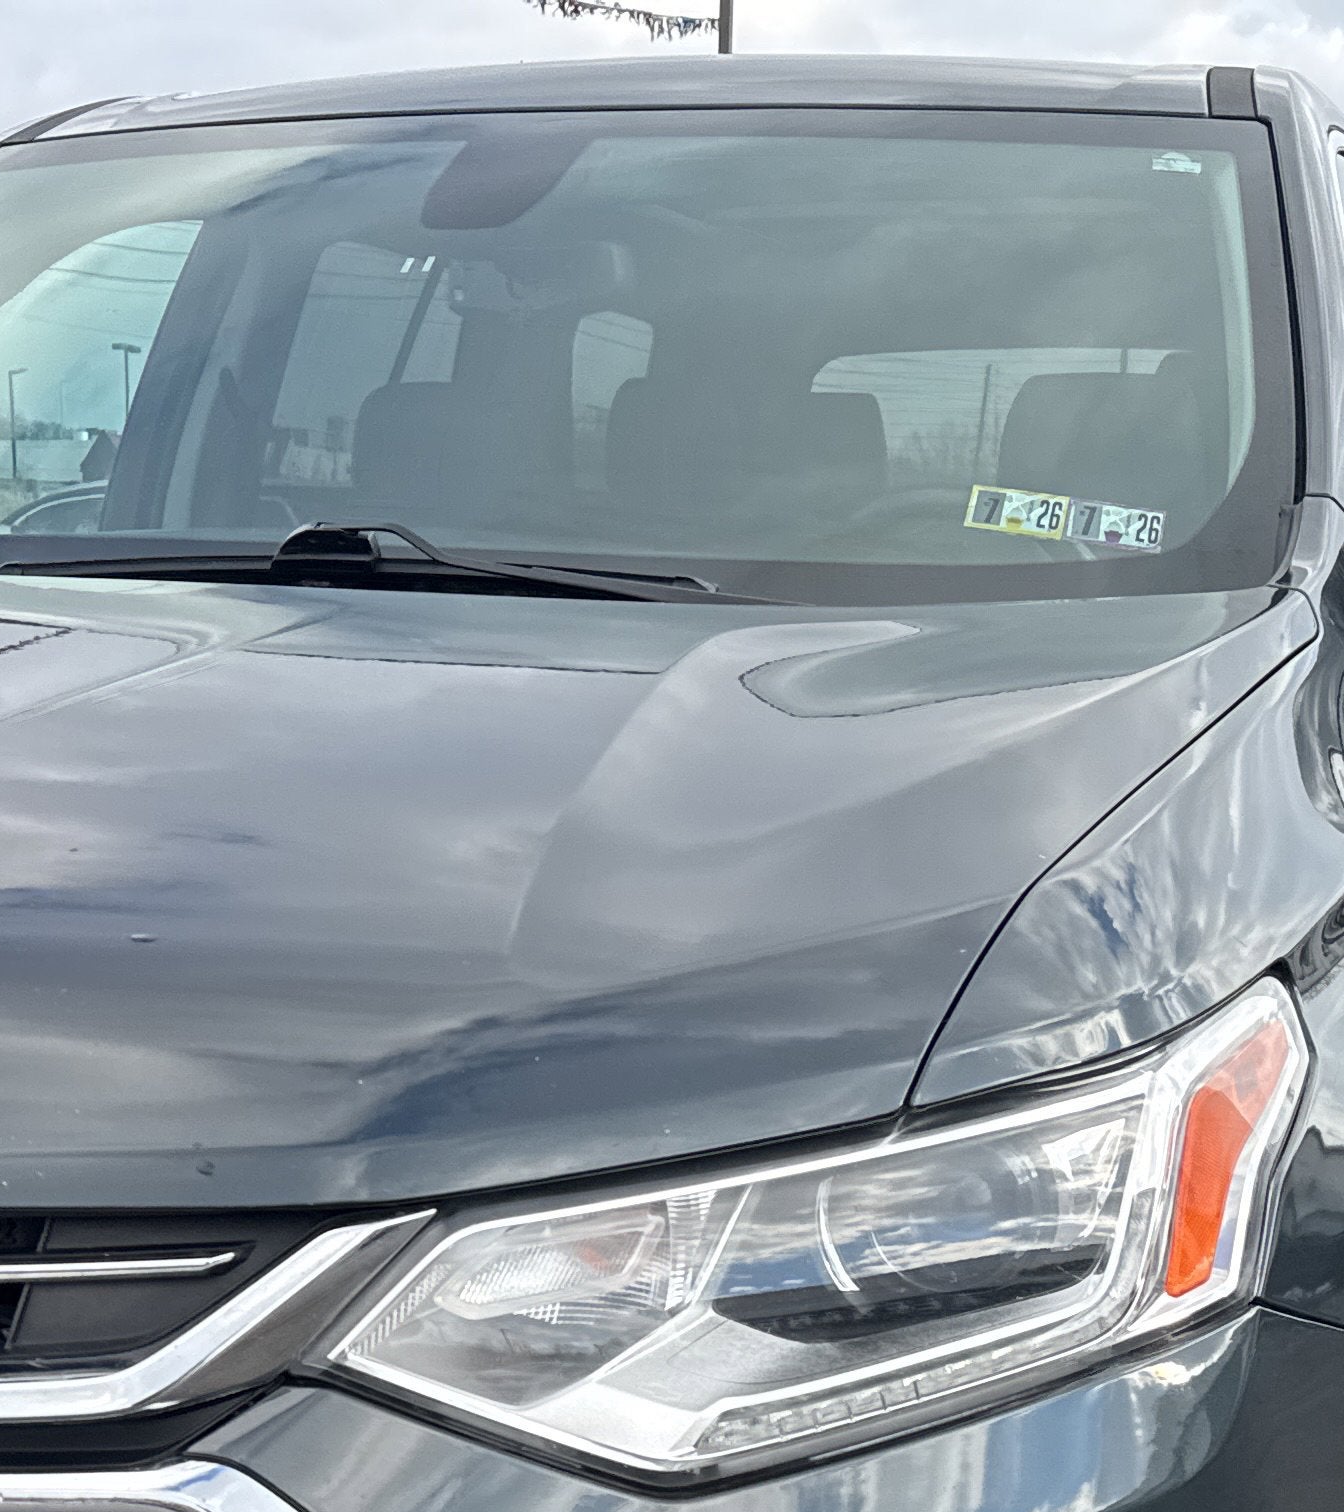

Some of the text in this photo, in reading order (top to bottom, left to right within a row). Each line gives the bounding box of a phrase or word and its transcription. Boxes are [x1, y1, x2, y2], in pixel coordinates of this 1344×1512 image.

[1036, 499, 1063, 530] 26
[1081, 505, 1161, 544] 7 26
